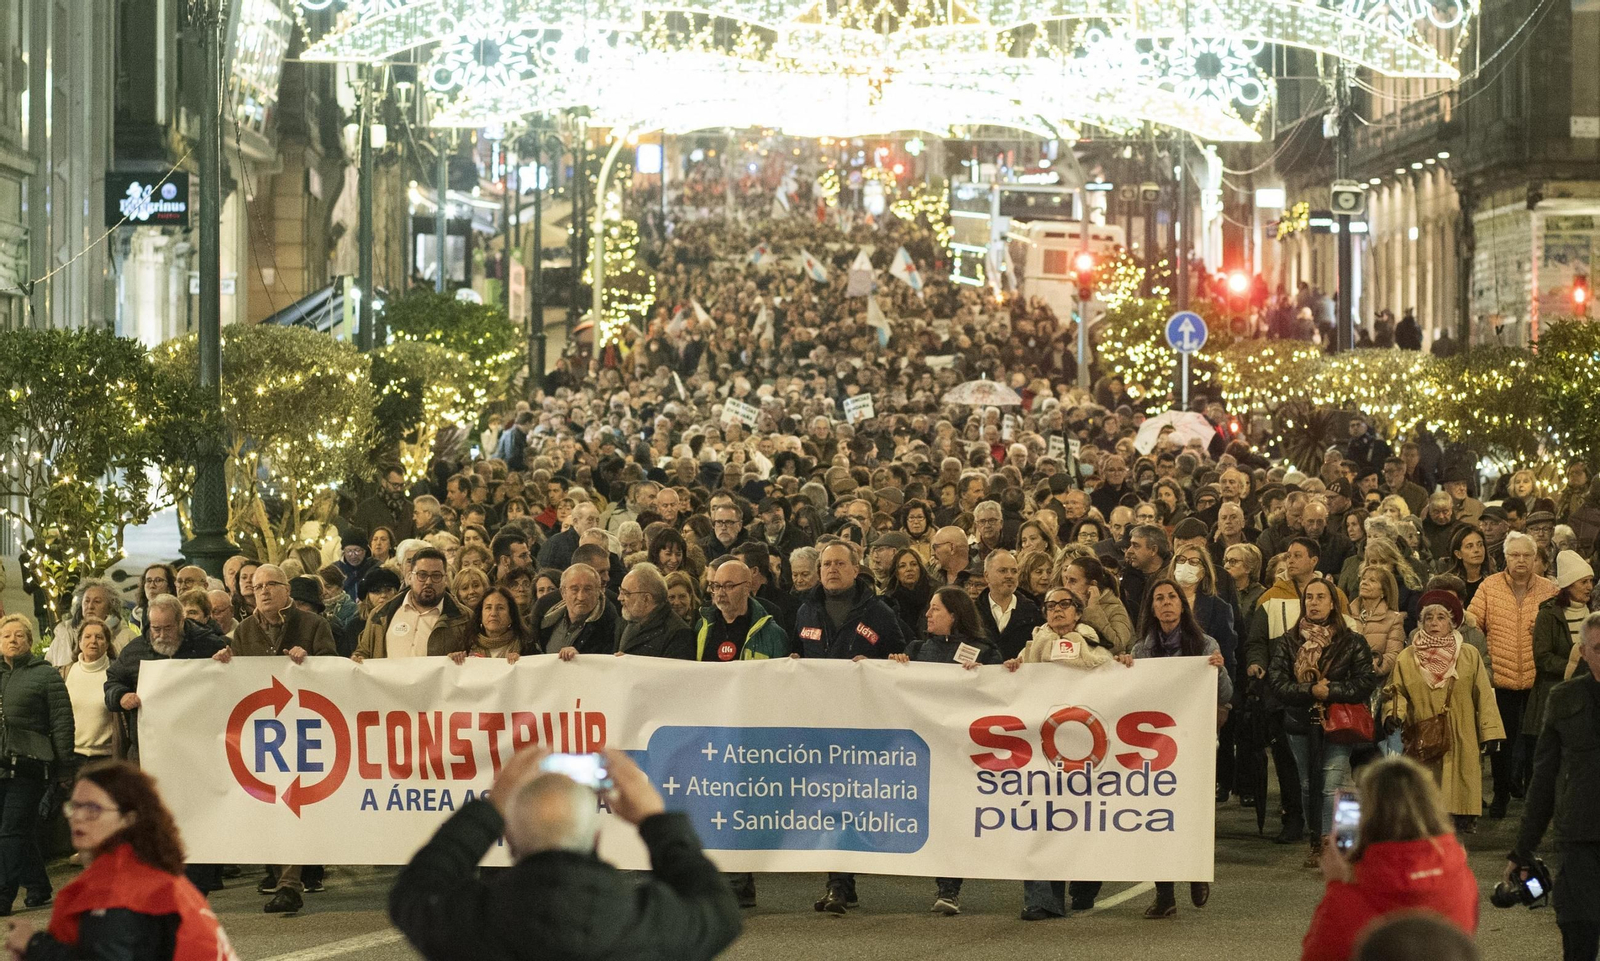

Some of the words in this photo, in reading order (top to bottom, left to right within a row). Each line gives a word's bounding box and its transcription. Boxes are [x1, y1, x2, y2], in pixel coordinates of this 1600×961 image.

[857, 623, 873, 638] UGT
[357, 698, 607, 781] CONSTRUÍR
[969, 704, 1179, 774] SOS
[723, 743, 822, 764] Atención
[829, 744, 918, 767] Primaria
[686, 776, 783, 797] Atención
[791, 777, 918, 803] Hospitalaria
[977, 763, 1178, 798] sanidade
[360, 788, 379, 811] A
[386, 783, 455, 812] ÁREA
[733, 809, 835, 832] Sanidade
[841, 811, 918, 835] Pública
[975, 801, 1175, 838] pública
